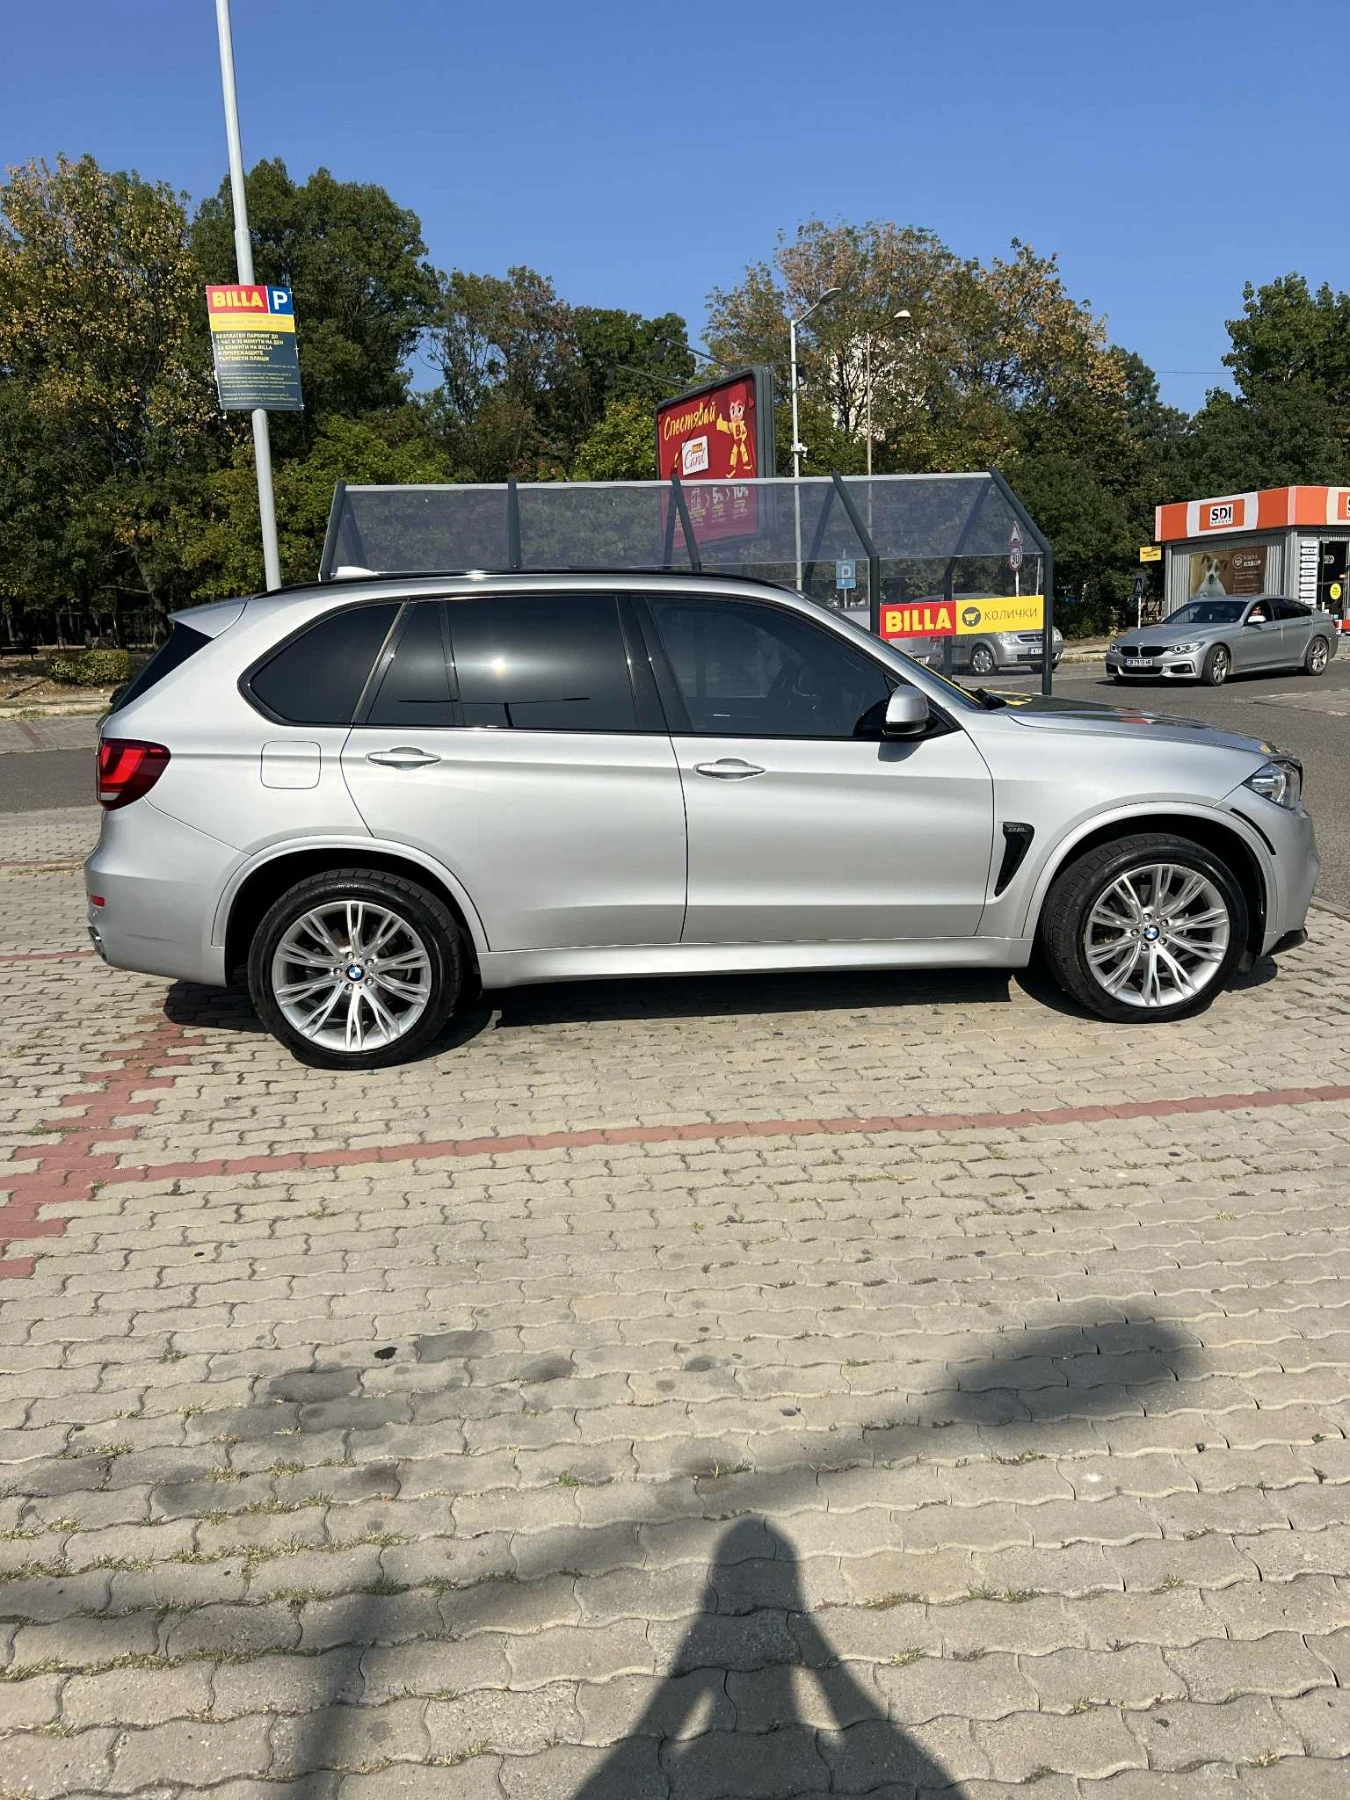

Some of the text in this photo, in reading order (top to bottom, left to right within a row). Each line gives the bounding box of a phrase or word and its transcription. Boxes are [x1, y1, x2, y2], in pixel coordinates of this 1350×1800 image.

[212, 290, 288, 310] BILLA P
[664, 401, 716, 441] Спестявай
[1212, 506, 1232, 521] SDI
[885, 608, 952, 633] BILLA
[984, 607, 1038, 621] КОЛИЧКИ
